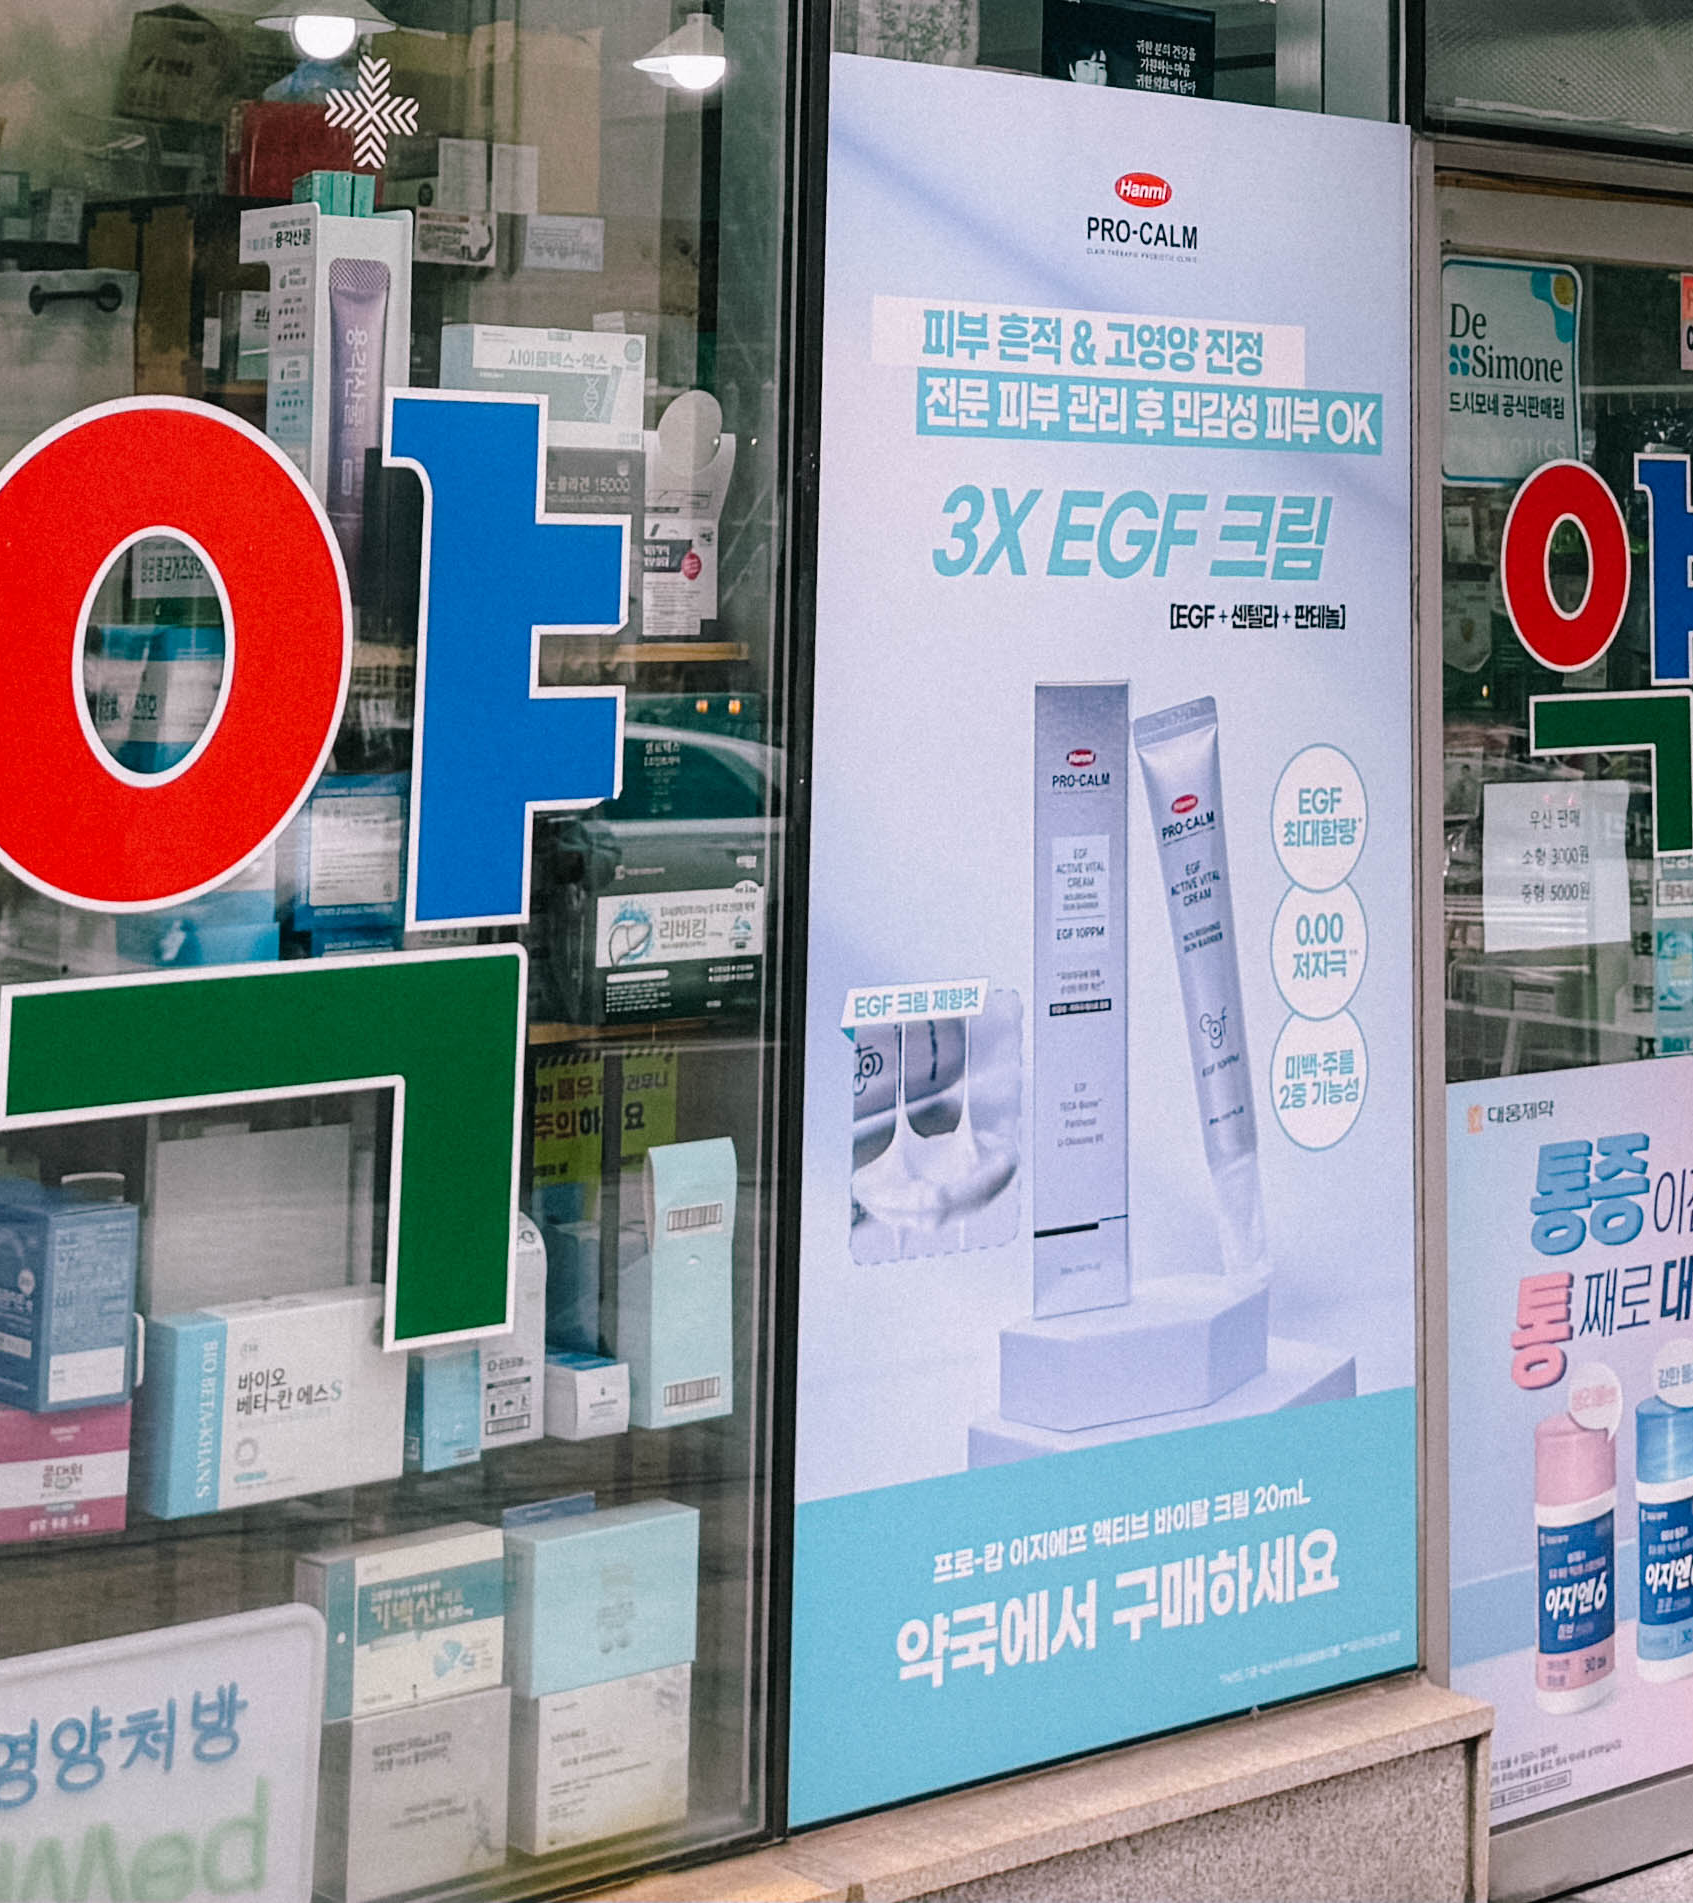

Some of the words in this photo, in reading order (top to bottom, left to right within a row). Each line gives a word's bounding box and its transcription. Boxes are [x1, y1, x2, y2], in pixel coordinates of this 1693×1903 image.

[1119, 179, 1168, 201] Hanmi
[1087, 216, 1198, 251] PRO-CALM
[1449, 303, 1487, 340] De
[923, 308, 990, 362] 피부
[998, 313, 1063, 365] 흔적
[1070, 319, 1097, 368] &
[1105, 322, 1200, 376] 고영양
[1205, 328, 1264, 377] 진정
[1471, 345, 1564, 384] Simone
[924, 375, 991, 429] 전문
[998, 381, 1060, 432] 피부
[1068, 386, 1128, 436] 관리
[1134, 388, 1165, 437] 후
[1172, 391, 1258, 442] 민감성
[1265, 397, 1321, 445] 피부
[1325, 402, 1377, 448] OK
[1449, 392, 1500, 416] 드시모네
[1502, 393, 1565, 421] 공식판매점
[931, 484, 1045, 578] 3X
[1046, 489, 1208, 580] EGF
[1209, 495, 1334, 582] 크림
[1230, 603, 1279, 631] 센텔라
[1052, 772, 1110, 789] PRO-CALM
[1297, 786, 1343, 816] EGF
[1161, 810, 1216, 841] PRO-CALM
[1283, 816, 1358, 847] 최대함량
[1529, 808, 1553, 831] 우산
[1521, 880, 1546, 905] 중형
[1549, 880, 1591, 902] 5000원
[659, 918, 707, 941] 리버킹
[1295, 911, 1345, 946] 0.00
[1292, 949, 1348, 981] 저자극
[854, 994, 894, 1019] EGF
[896, 991, 929, 1015] 크림
[932, 987, 980, 1014] 제형컷
[1311, 1076, 1360, 1106] 기능성
[1486, 1100, 1555, 1124] 대웅제약
[1530, 1132, 1651, 1256] 통증
[237, 1367, 288, 1393] 바이오
[236, 1387, 293, 1415] 베타-칸
[932, 1541, 1006, 1585] 프로-캄
[1009, 1529, 1089, 1567] 이지에프
[1092, 1514, 1151, 1551] 액티브
[1154, 1499, 1210, 1535] 바이탈
[1213, 1488, 1251, 1522] 크림
[1253, 1478, 1312, 1518] 20mL
[894, 1578, 1098, 1691] 약국에서
[1112, 1527, 1341, 1643] 구매하세요
[1544, 1571, 1608, 1621] 이지엔6
